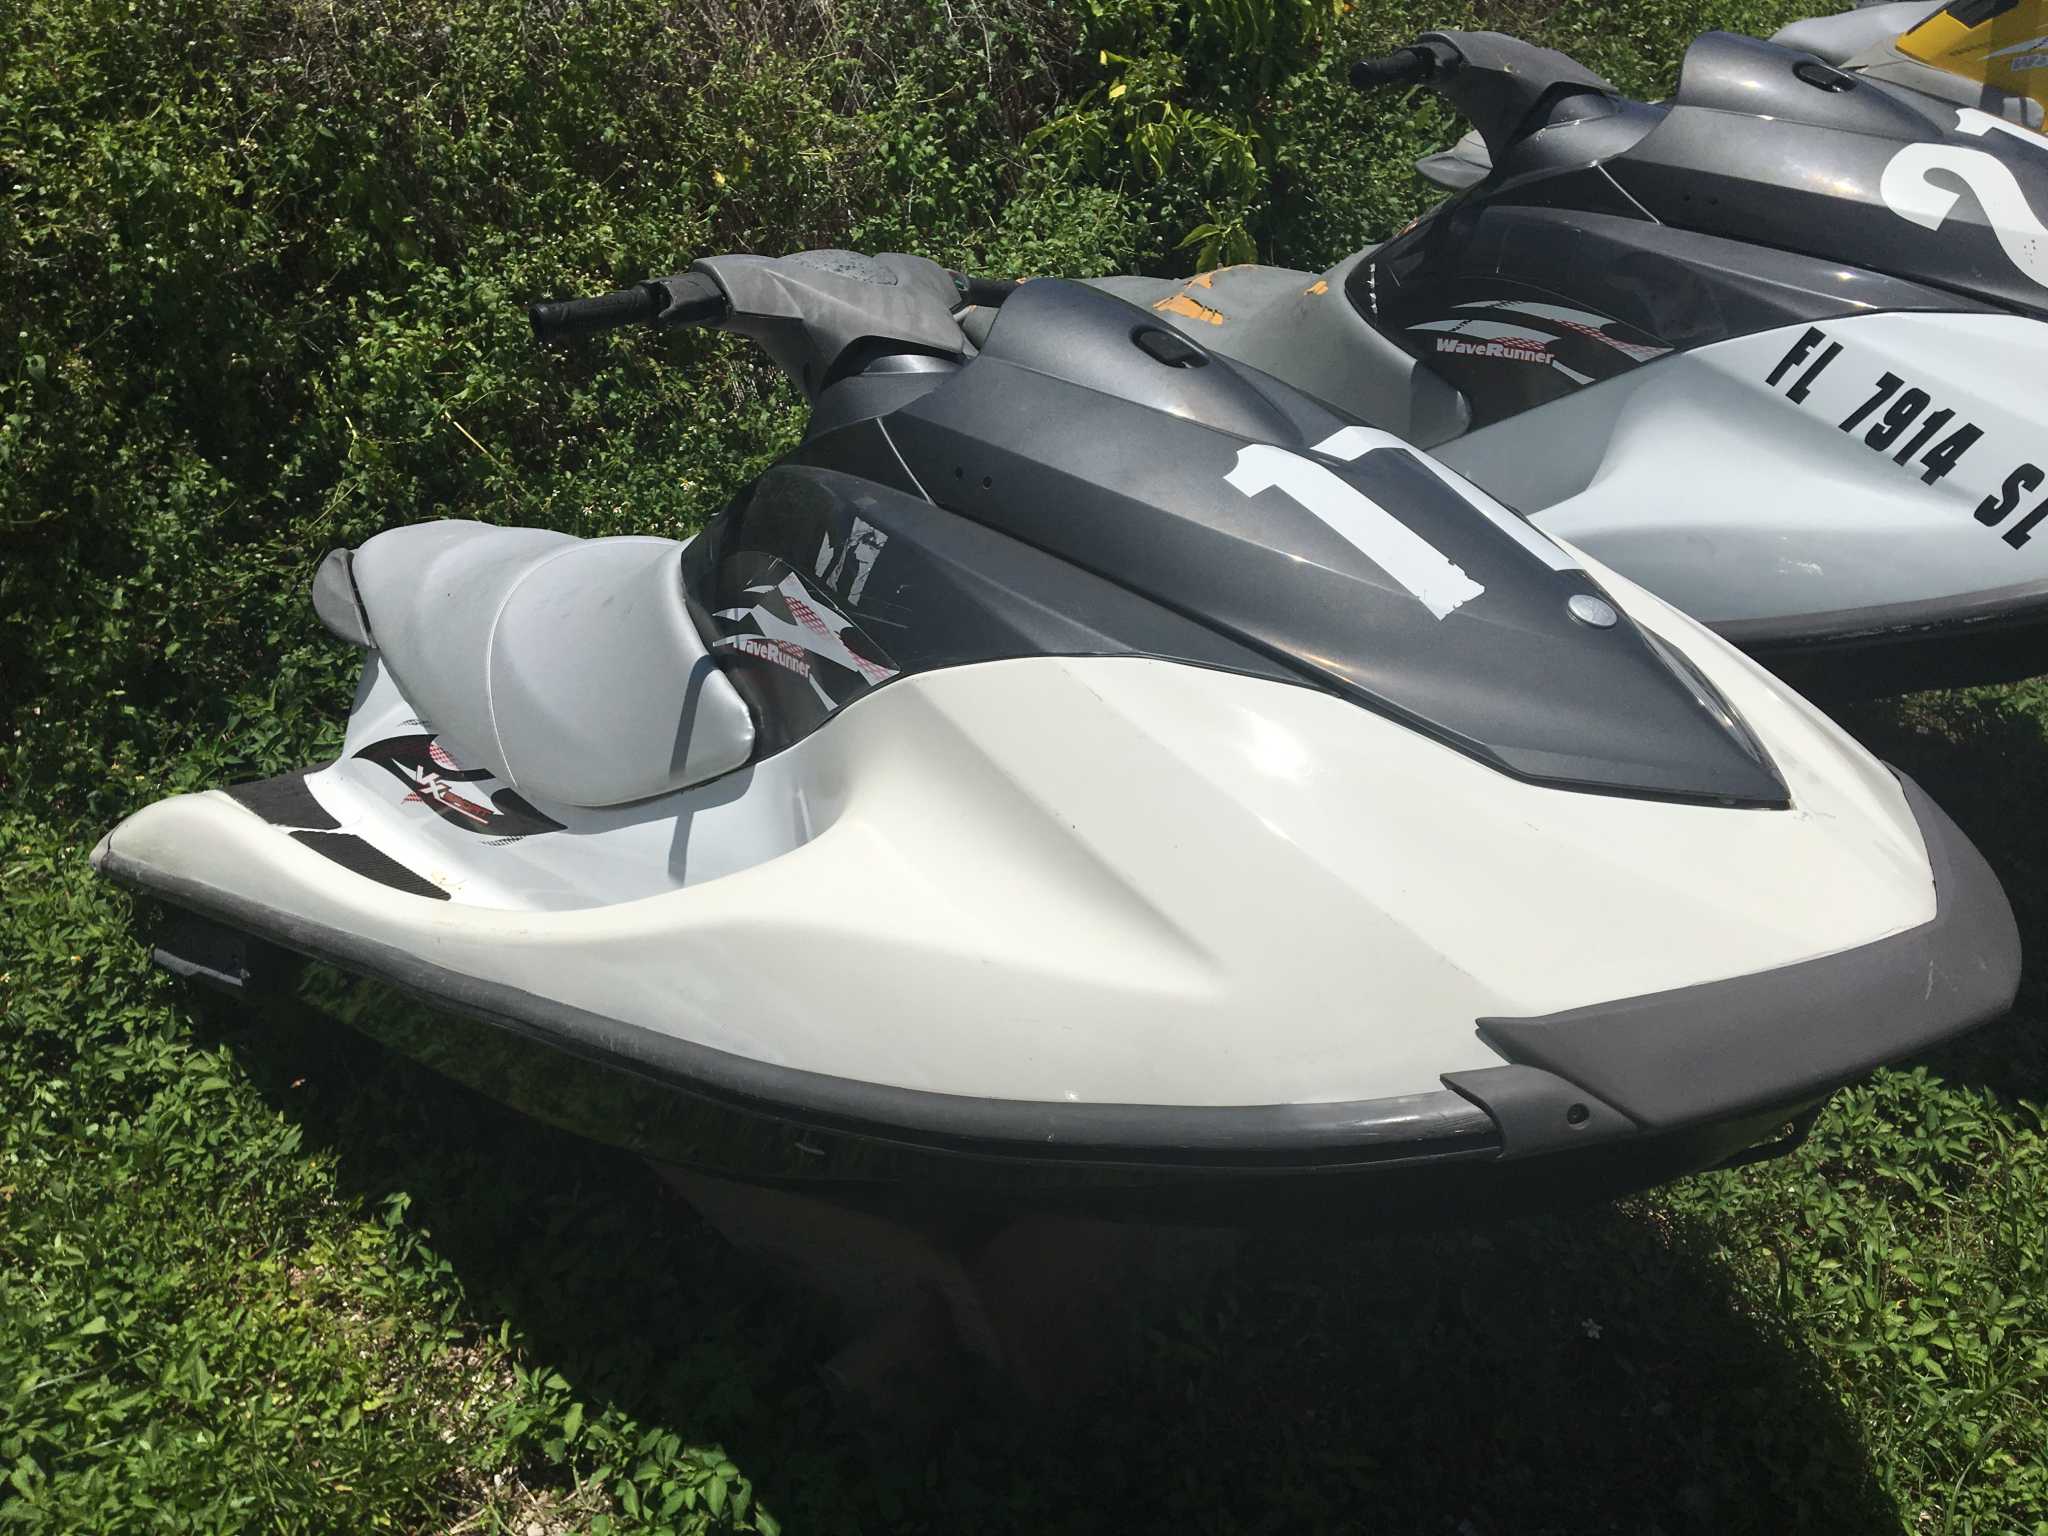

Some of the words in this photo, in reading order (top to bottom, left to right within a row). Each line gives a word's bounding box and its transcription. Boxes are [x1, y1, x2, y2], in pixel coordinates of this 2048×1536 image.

[1436, 337, 1554, 365] WaveRunner
[1764, 325, 1845, 406] FL
[1837, 371, 1985, 486] 7914
